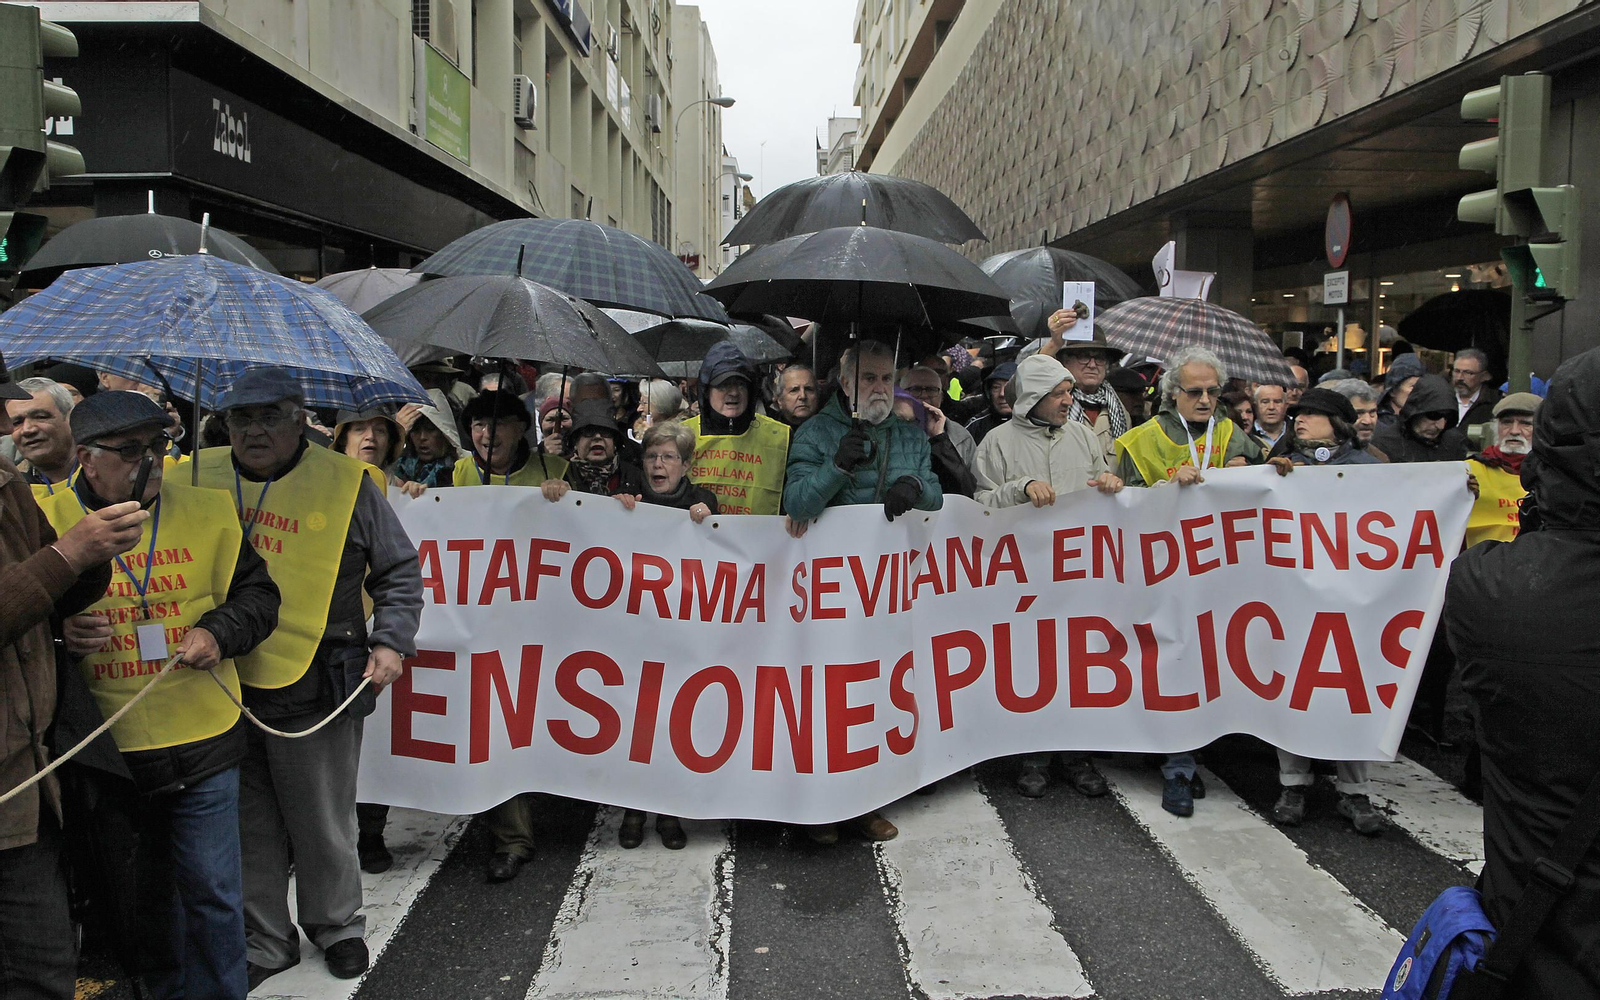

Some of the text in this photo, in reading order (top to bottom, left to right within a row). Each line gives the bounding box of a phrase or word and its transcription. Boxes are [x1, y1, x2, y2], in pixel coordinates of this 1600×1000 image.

[693, 449, 763, 465] LATAFORMA
[691, 466, 754, 481] SEVILLANA
[701, 483, 747, 498] EFENSA
[112, 548, 194, 575] AFORMA
[418, 539, 766, 624] ATAFORMA
[1053, 525, 1125, 584] EN
[1139, 508, 1445, 587] DEFENSA
[374, 595, 1426, 774] ENSIONES PÚBLICAS
